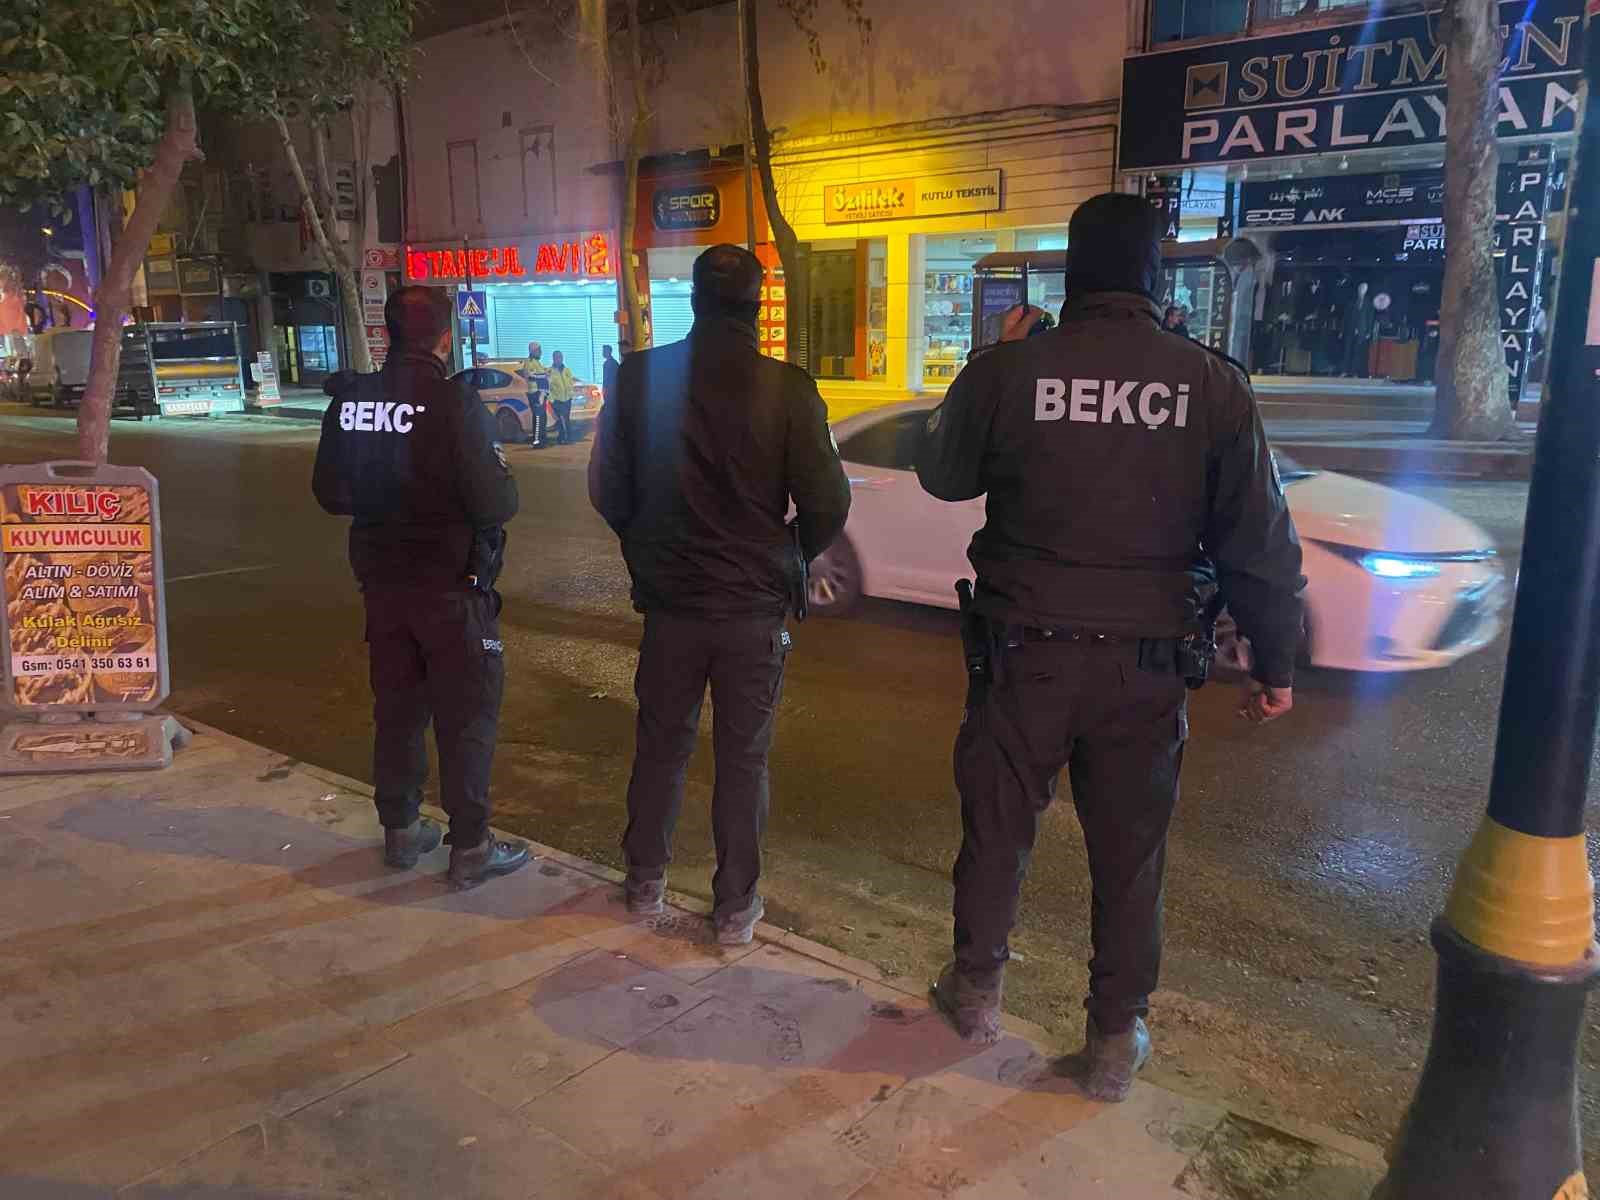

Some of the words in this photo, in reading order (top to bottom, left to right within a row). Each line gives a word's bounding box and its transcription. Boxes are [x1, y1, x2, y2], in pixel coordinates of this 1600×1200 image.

[1238, 15, 1580, 102] SUİTMN
[921, 191, 953, 201] KUTLU
[956, 184, 997, 199] TEKSTİL
[27, 491, 121, 520] KILIÇ
[11, 529, 142, 547] KUYUMCULUK
[25, 565, 72, 579] ALTIN
[86, 561, 134, 578] DÖVİZ
[22, 585, 64, 600] ALIM
[69, 586, 82, 598] &
[86, 585, 139, 599] SATIMI
[22, 615, 76, 629] Kulak
[82, 614, 142, 629] Ağrısız
[55, 635, 114, 649] Delinir
[22, 660, 52, 672] Gsm:
[56, 658, 86, 671] 0541
[91, 657, 114, 670] 350
[117, 657, 133, 669] 63
[136, 656, 151, 669] 61
